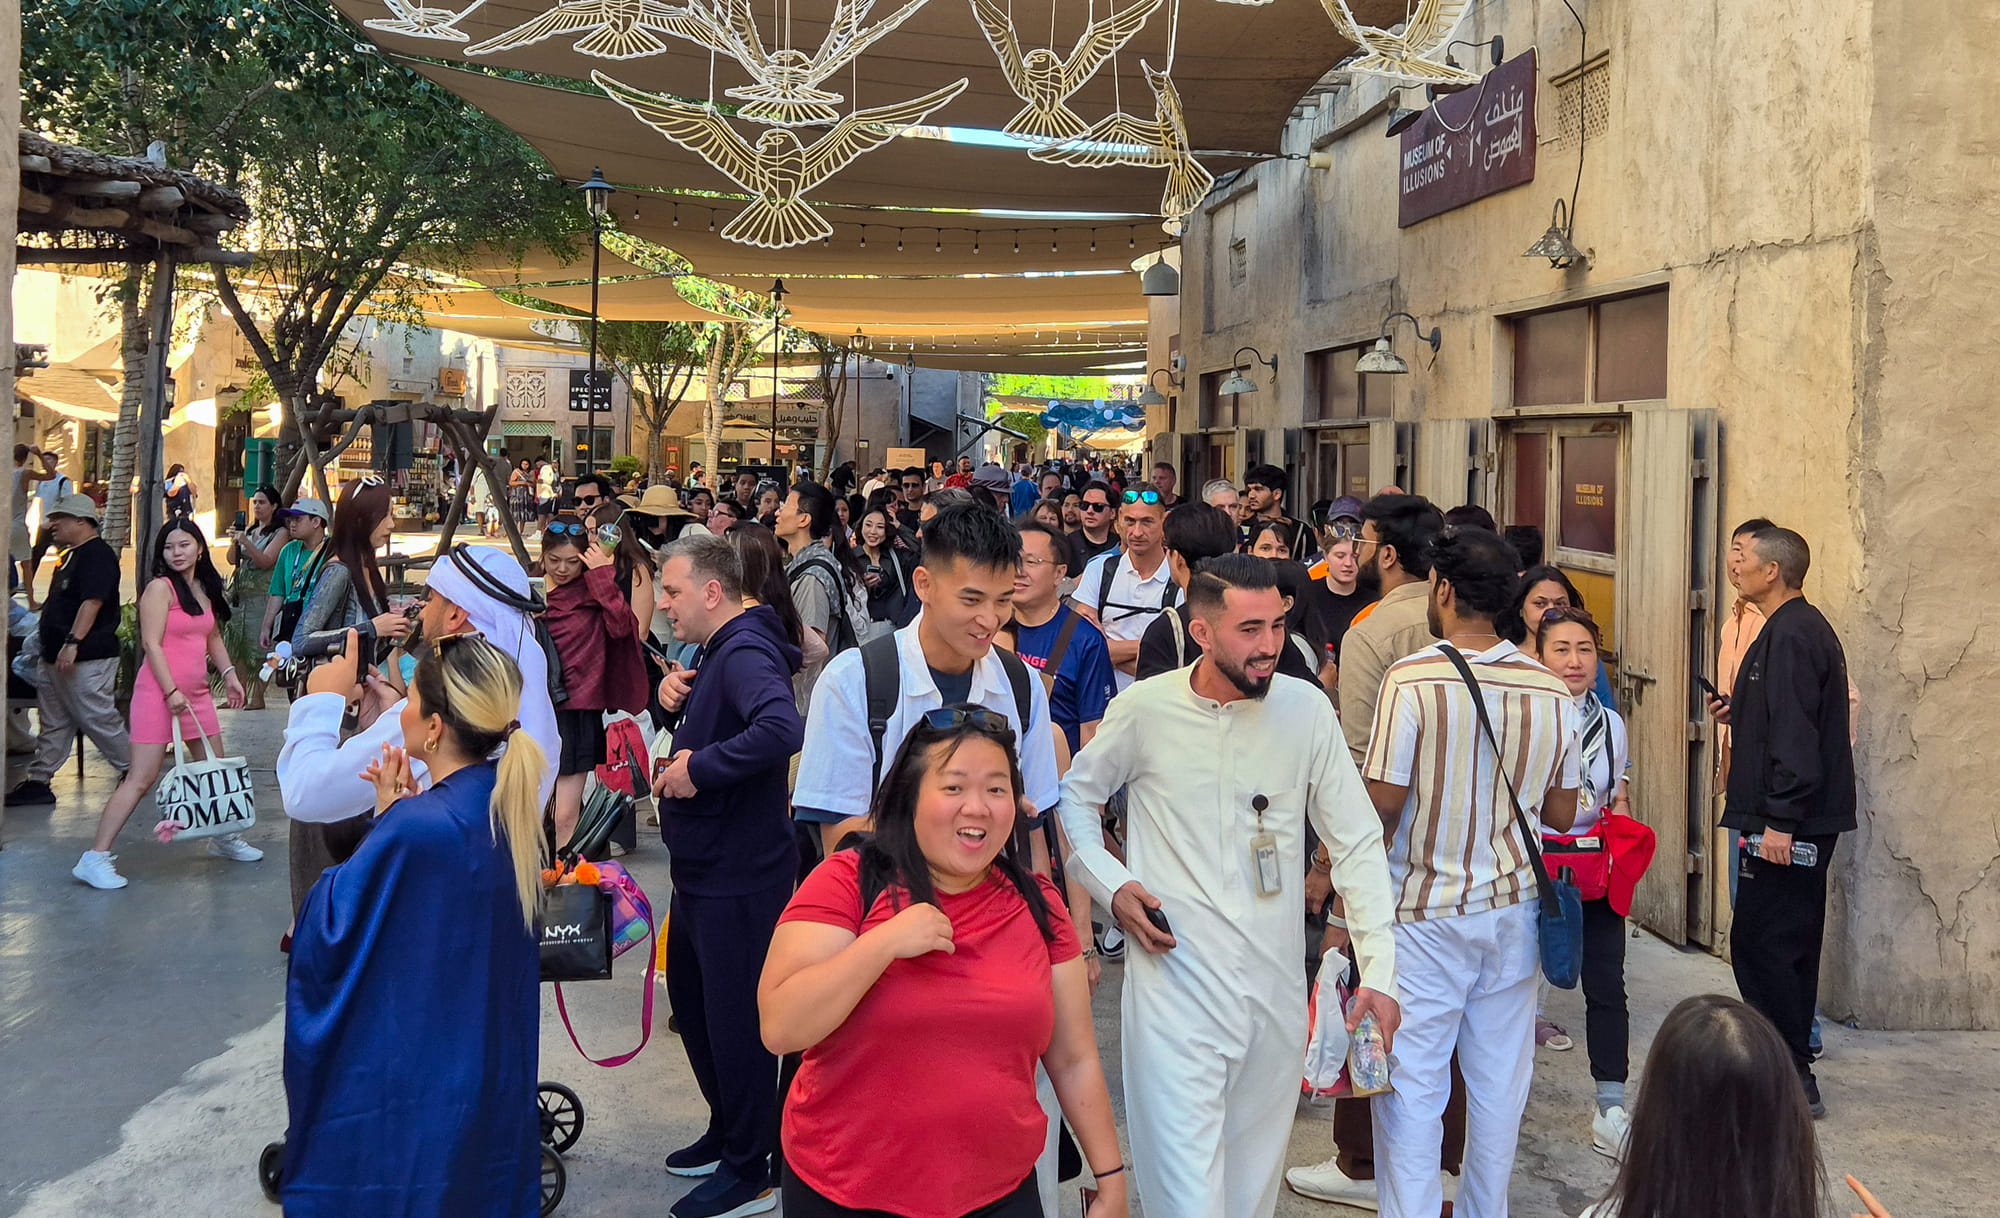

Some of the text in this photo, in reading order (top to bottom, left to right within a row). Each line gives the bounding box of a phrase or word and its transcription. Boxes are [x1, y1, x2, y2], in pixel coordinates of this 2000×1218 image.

[1403, 132, 1447, 170] MUSEUM OF
[1484, 114, 1523, 171] الغموض
[1403, 160, 1445, 194] ILLUSIONS
[545, 923, 581, 941] NYX
